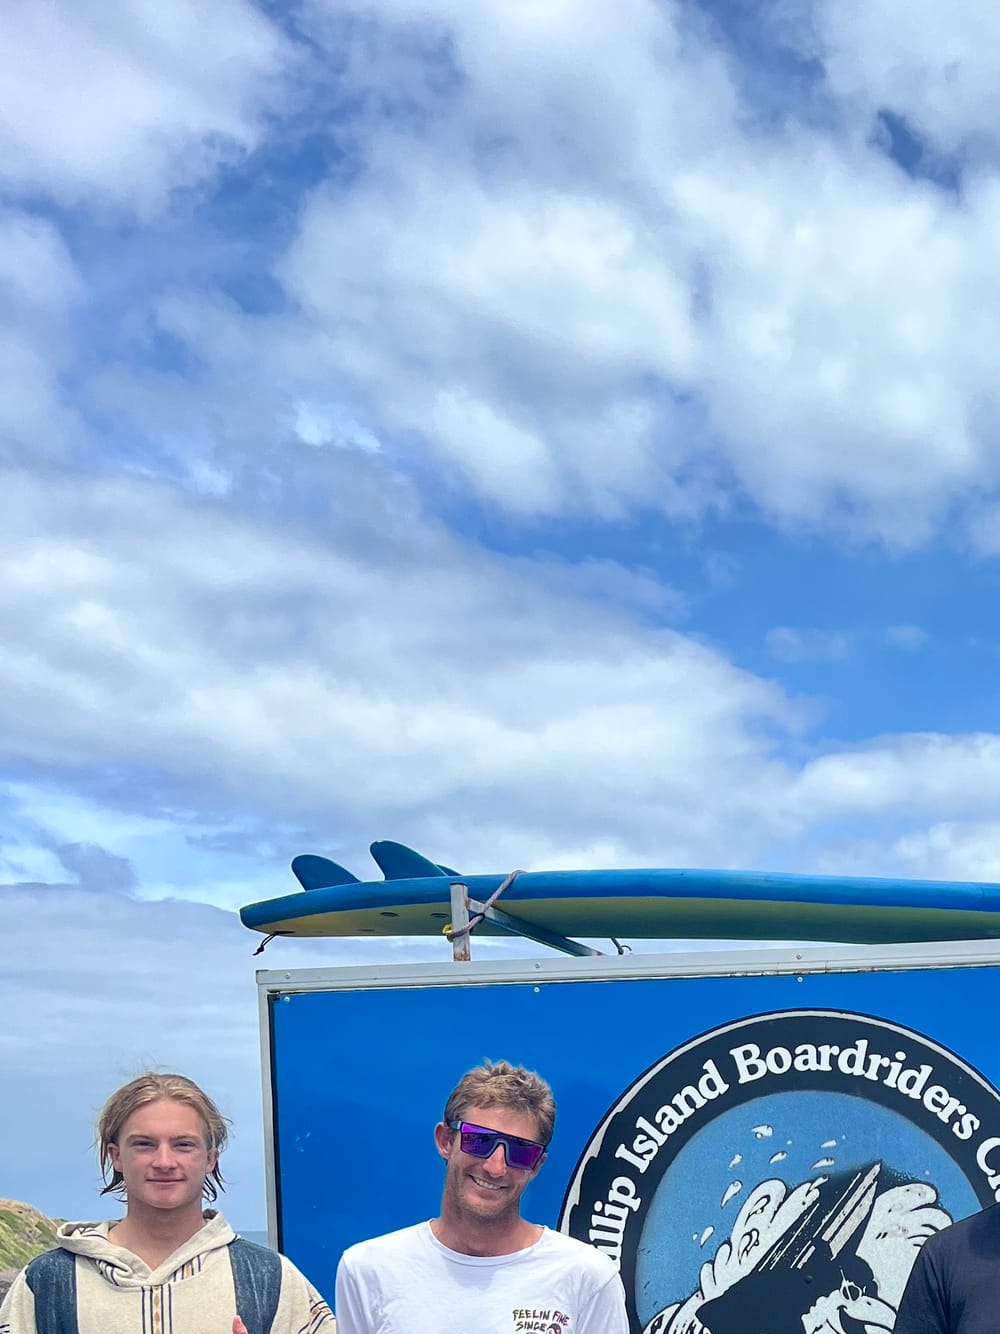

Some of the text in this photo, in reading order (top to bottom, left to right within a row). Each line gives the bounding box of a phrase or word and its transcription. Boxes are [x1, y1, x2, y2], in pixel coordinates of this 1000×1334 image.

[615, 1058, 729, 1174] Island
[730, 1039, 981, 1140] Boardriders
[512, 1309, 570, 1326] FEELIN FINE
